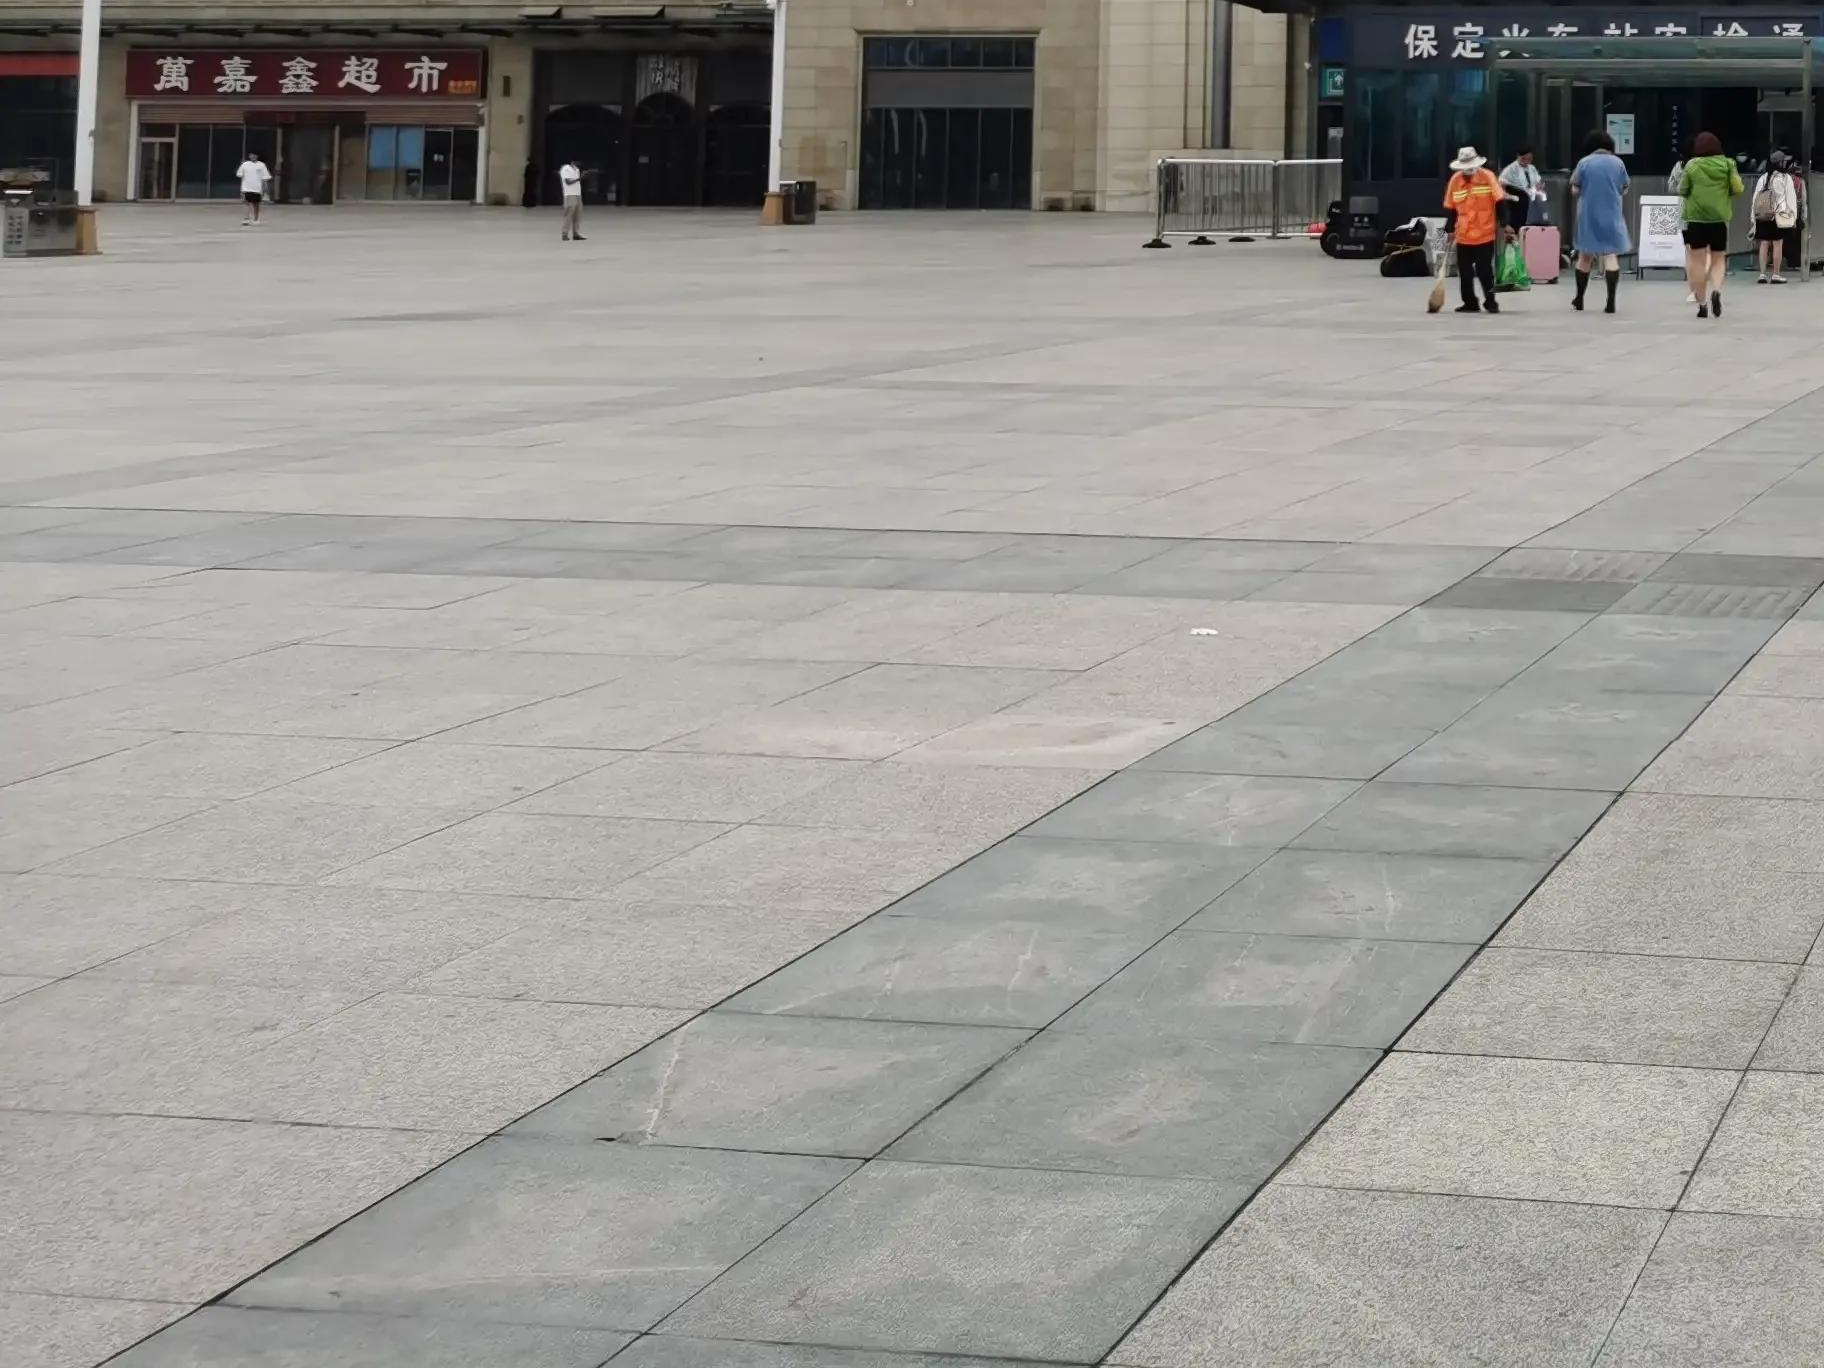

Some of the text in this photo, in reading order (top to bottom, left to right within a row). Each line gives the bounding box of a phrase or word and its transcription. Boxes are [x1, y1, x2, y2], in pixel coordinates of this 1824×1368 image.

[154, 55, 448, 94] 萬嘉鑫超市
